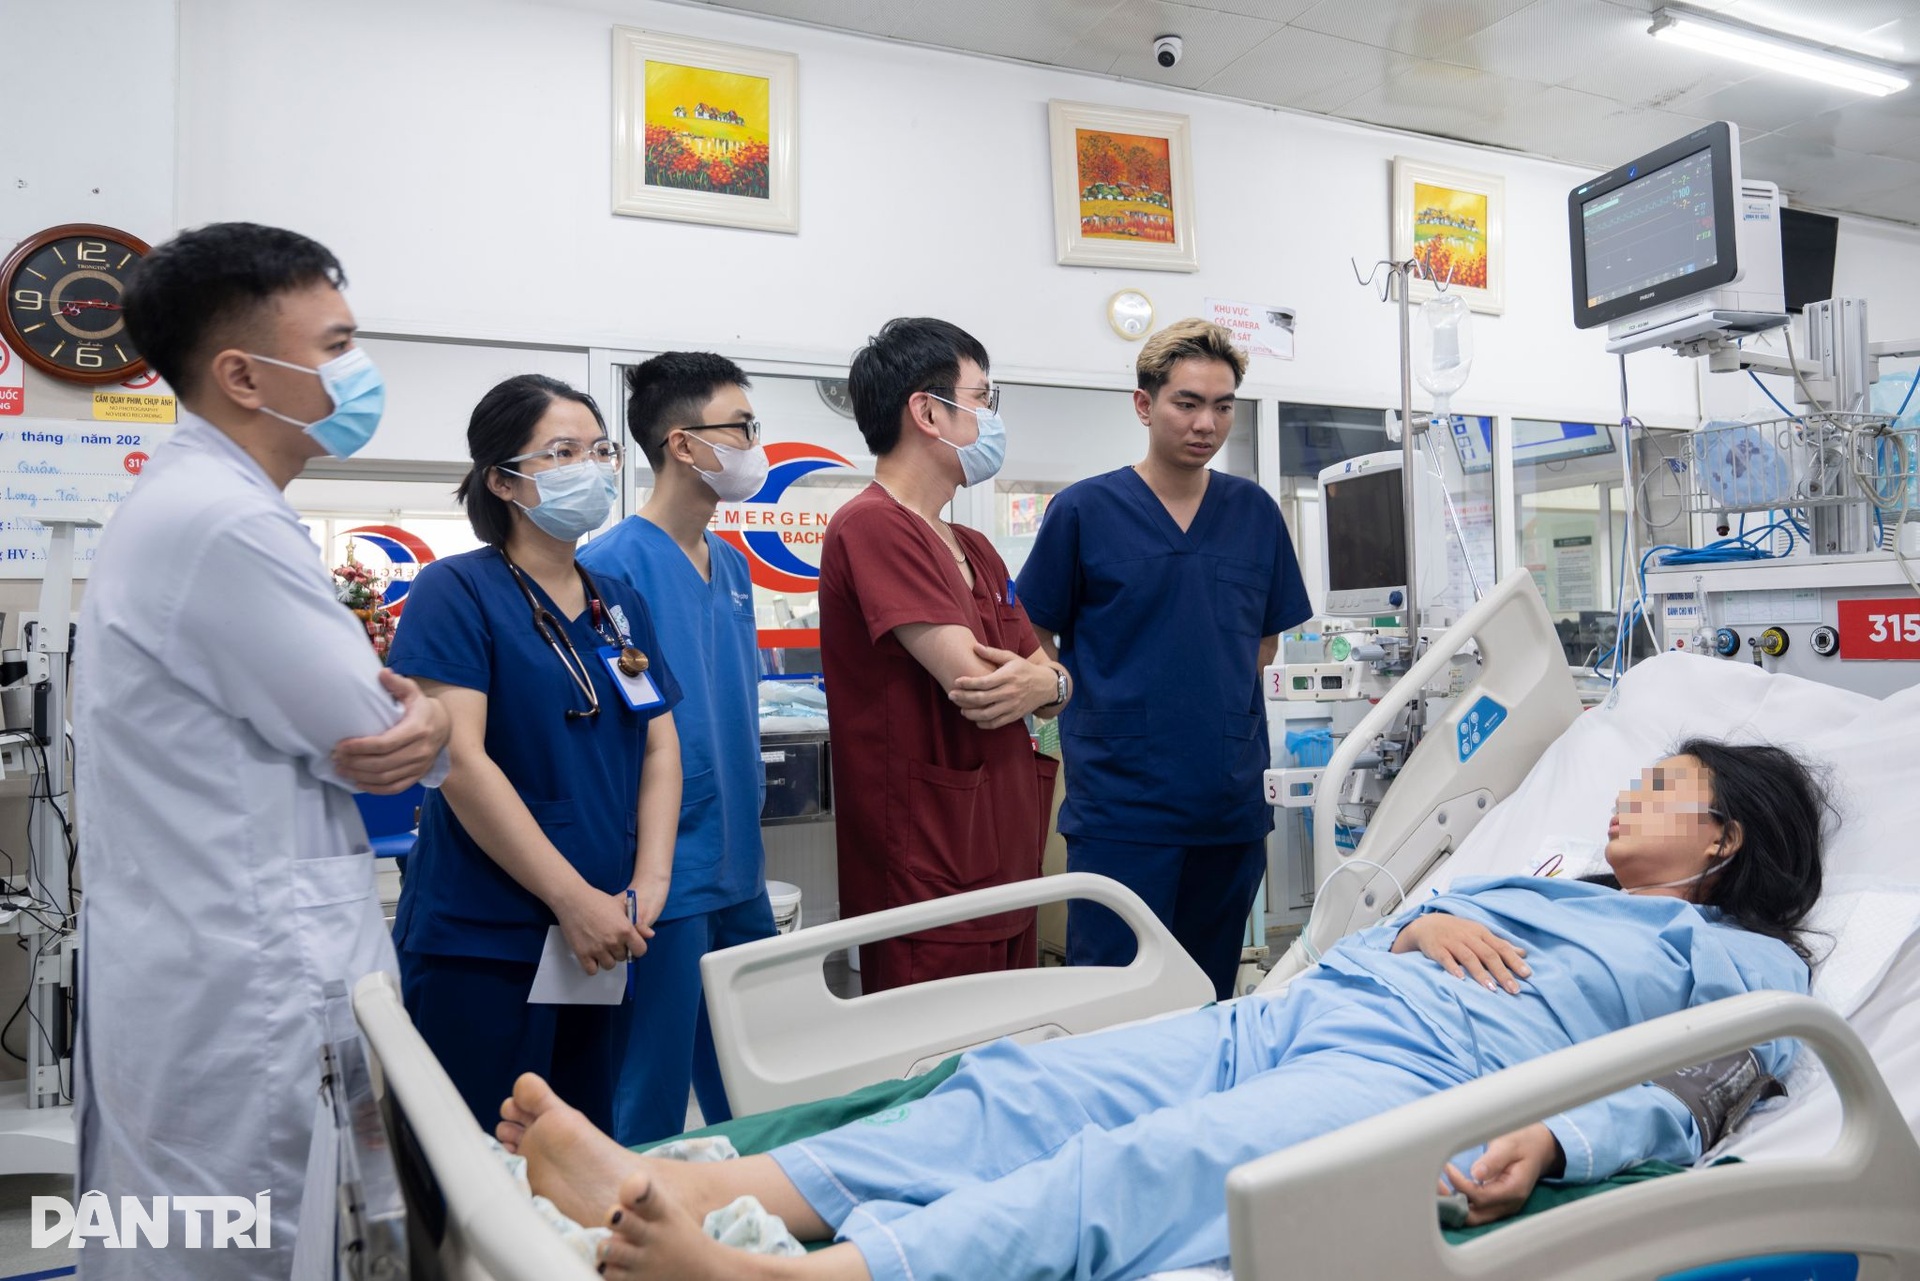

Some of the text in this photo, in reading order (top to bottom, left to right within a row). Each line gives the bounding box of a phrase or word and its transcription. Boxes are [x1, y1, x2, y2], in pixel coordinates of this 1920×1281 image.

[77, 241, 107, 262] 12
[15, 289, 43, 311] 9
[1214, 304, 1250, 316] KHU VỰC
[1227, 318, 1260, 330] CAMERA
[76, 346, 102, 368] 6
[110, 395, 125, 404] QUAY
[144, 397, 159, 407] CHỤP
[840, 396, 846, 405] 7
[21, 431, 63, 445] tháng
[81, 433, 112, 445] năm
[116, 434, 141, 446] 202
[7, 548, 28, 560] HV
[1868, 613, 1920, 643] 315
